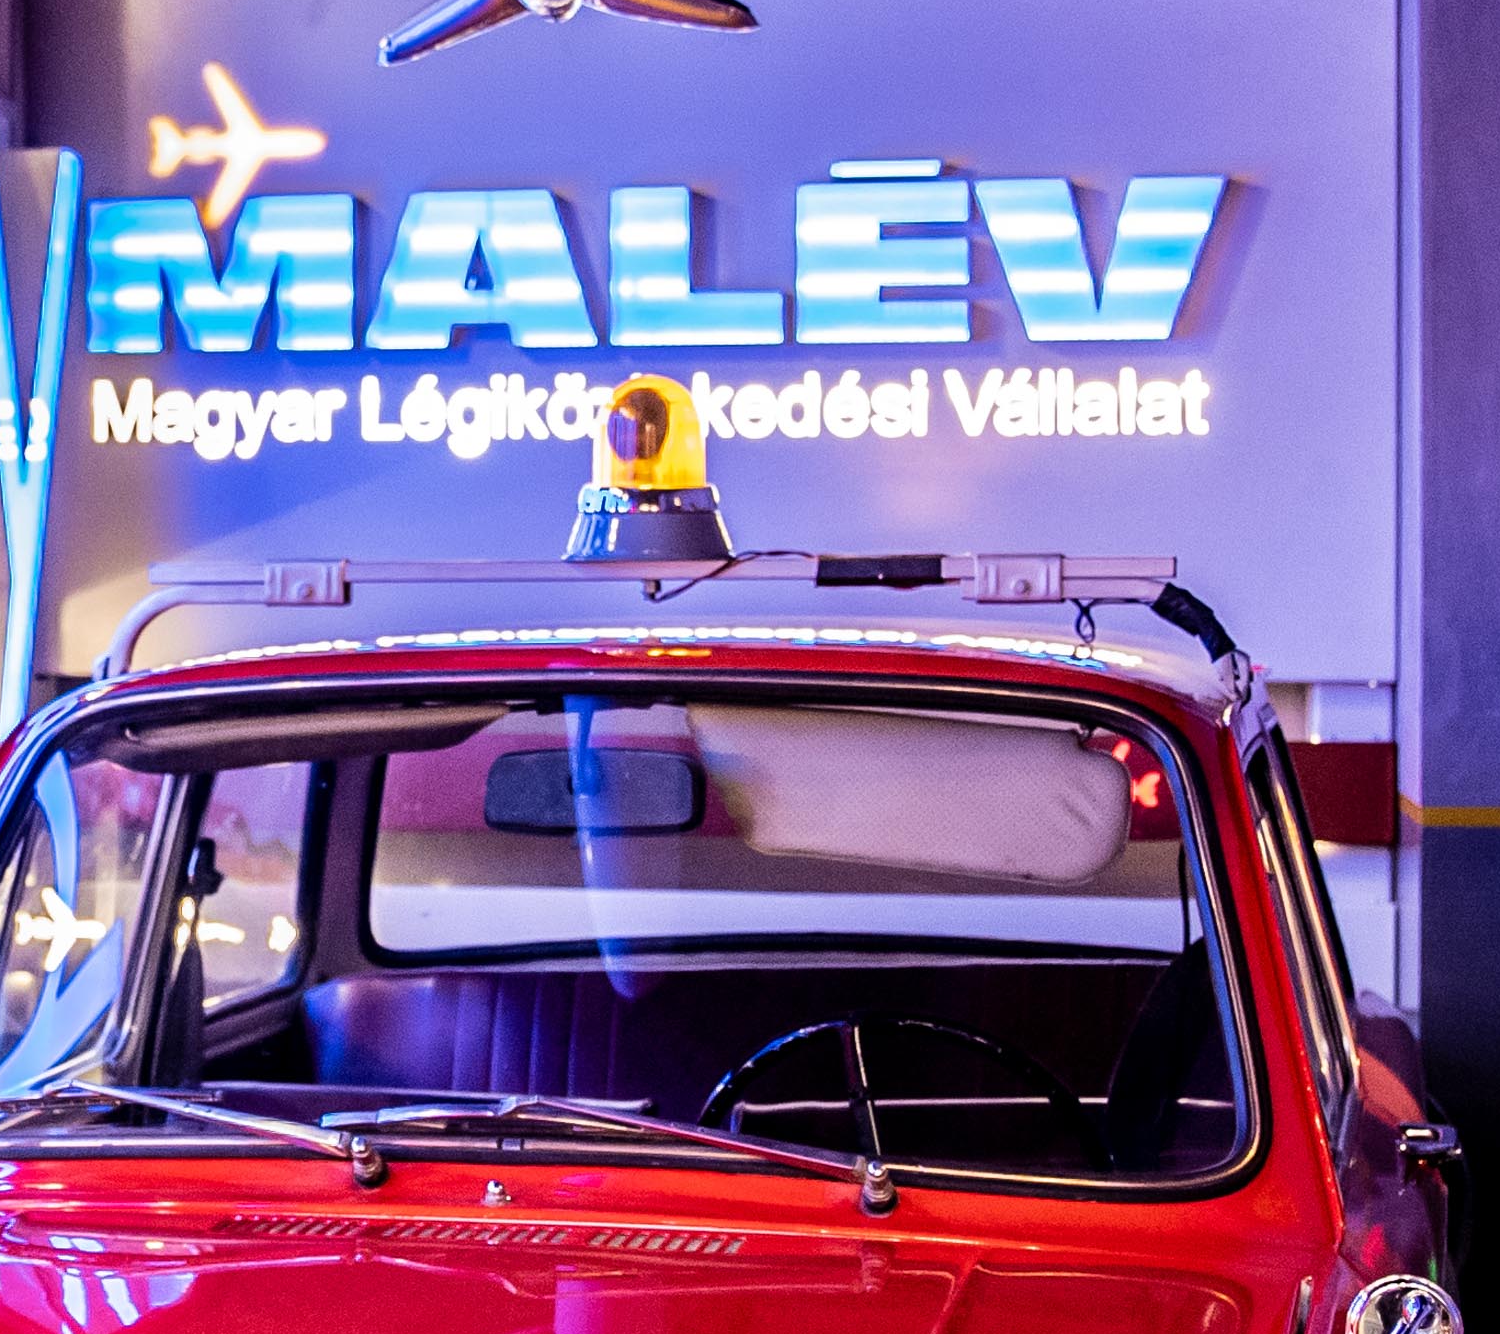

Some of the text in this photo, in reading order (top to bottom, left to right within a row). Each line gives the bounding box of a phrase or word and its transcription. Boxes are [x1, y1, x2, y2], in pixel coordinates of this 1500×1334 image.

[91, 366, 1211, 460] Magyar Légikökedési Vállalat
